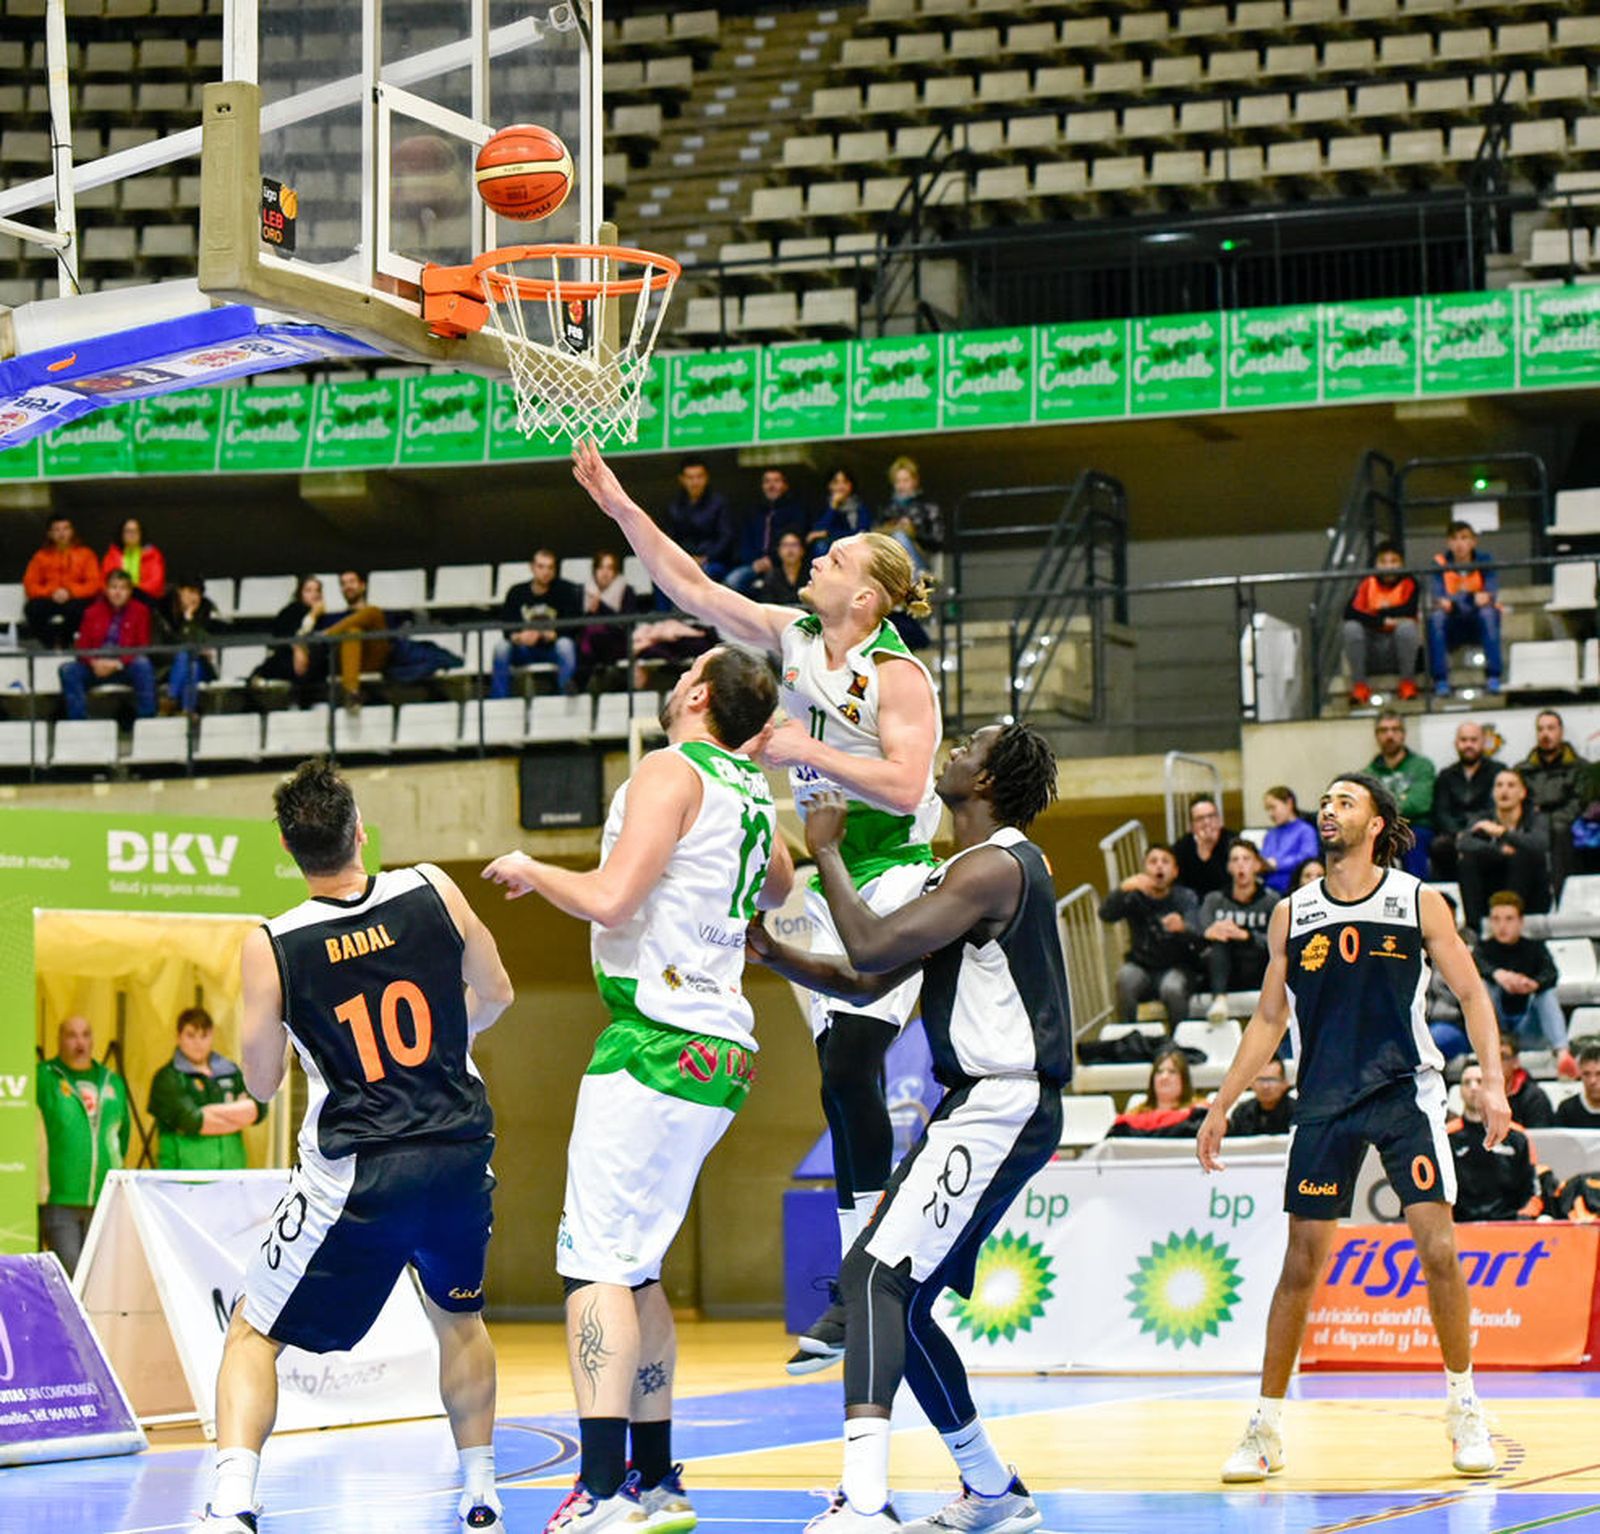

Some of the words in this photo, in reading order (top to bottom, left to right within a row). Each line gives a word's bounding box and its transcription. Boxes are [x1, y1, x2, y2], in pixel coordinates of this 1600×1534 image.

[263, 208, 284, 230] LEB
[263, 226, 283, 243] ORO
[808, 704, 827, 741] 11
[107, 829, 239, 876] DKV
[325, 924, 396, 964] BADAL
[1339, 925, 1360, 964] 0
[334, 979, 432, 1083] 10
[1411, 1154, 1436, 1191] 0
[1025, 1187, 1070, 1226] bp
[1209, 1187, 1255, 1227] bp
